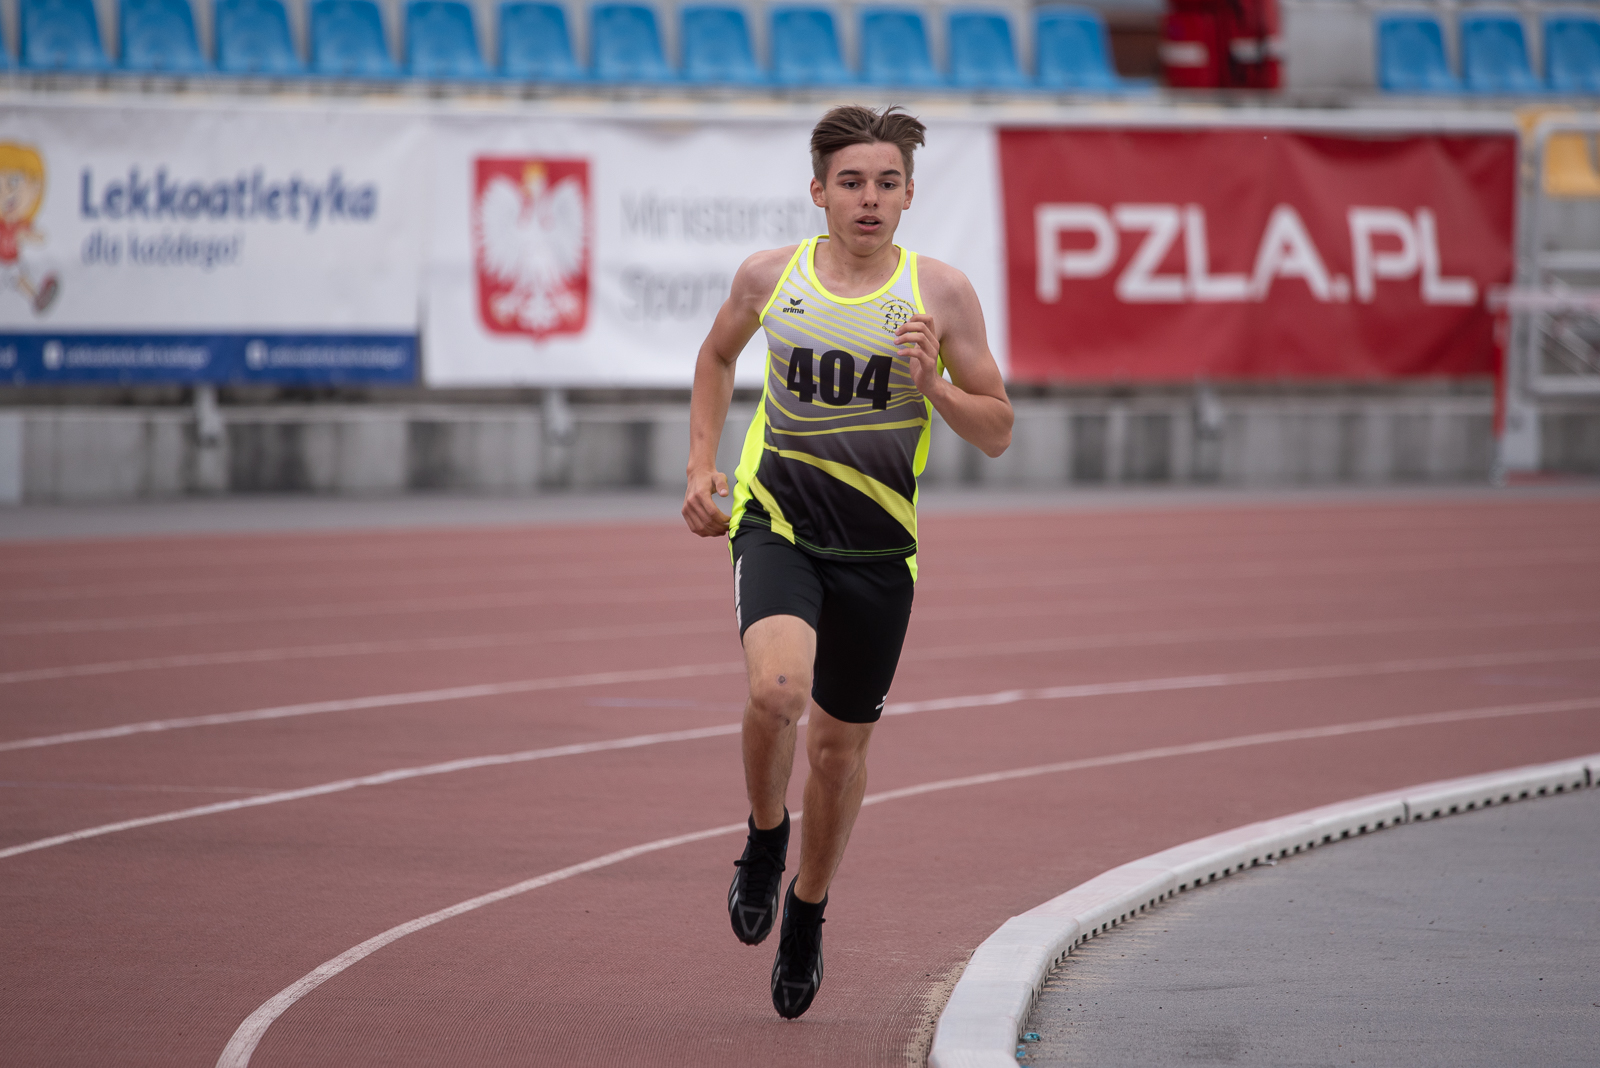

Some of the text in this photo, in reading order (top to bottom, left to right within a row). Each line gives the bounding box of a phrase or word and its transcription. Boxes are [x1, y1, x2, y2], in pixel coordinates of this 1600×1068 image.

[79, 166, 378, 233] Lekkoatletyka
[1035, 204, 1476, 305] PZLA.PL
[782, 306, 805, 315] erima
[786, 347, 893, 411] 404
